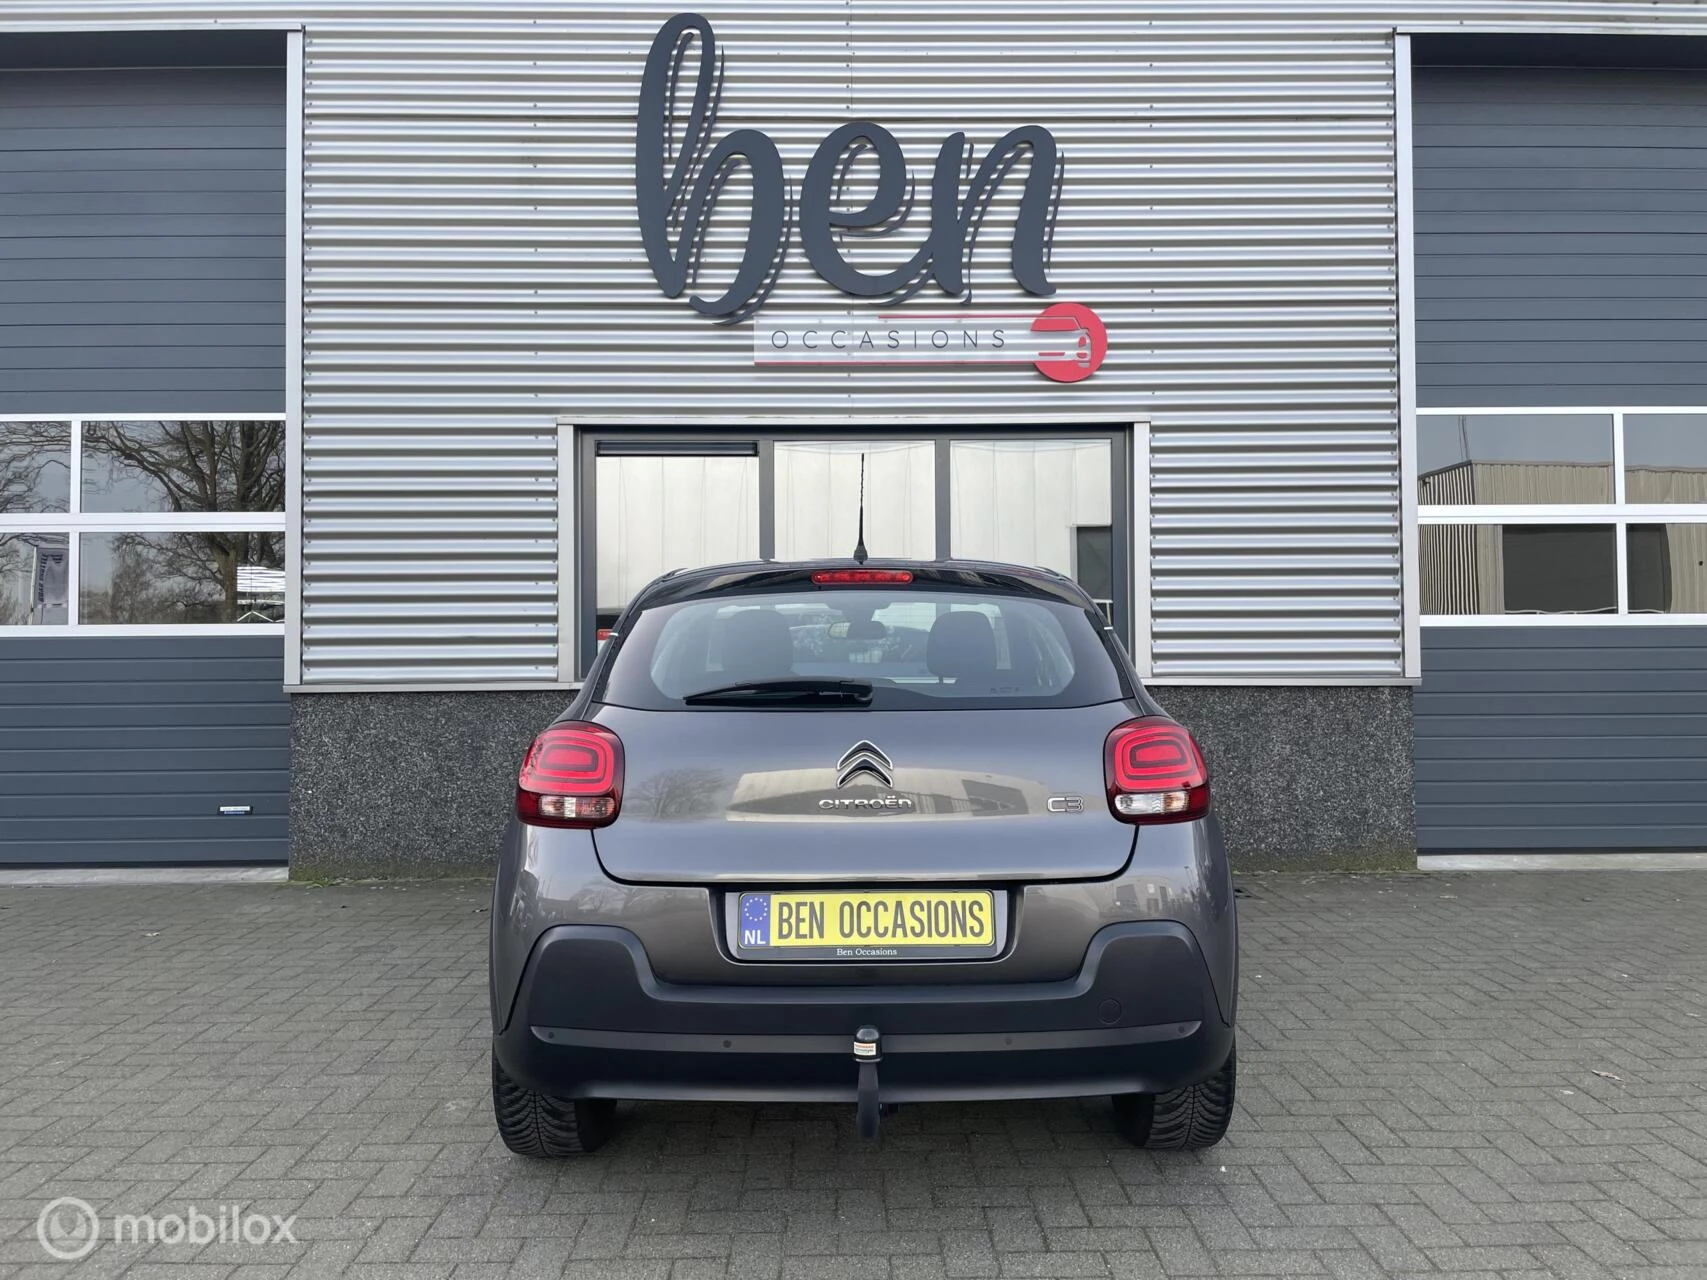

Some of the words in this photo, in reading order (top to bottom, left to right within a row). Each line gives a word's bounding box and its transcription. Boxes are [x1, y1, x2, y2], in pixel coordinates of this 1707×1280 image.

[635, 12, 1058, 316] ben
[771, 329, 1007, 349] OCCASIONS
[1047, 796, 1084, 812] C3
[777, 901, 825, 940] BEN
[838, 900, 985, 939] OCCASIONS
[744, 930, 766, 945] NL
[836, 947, 853, 956] Ben
[855, 947, 898, 956] Occasions
